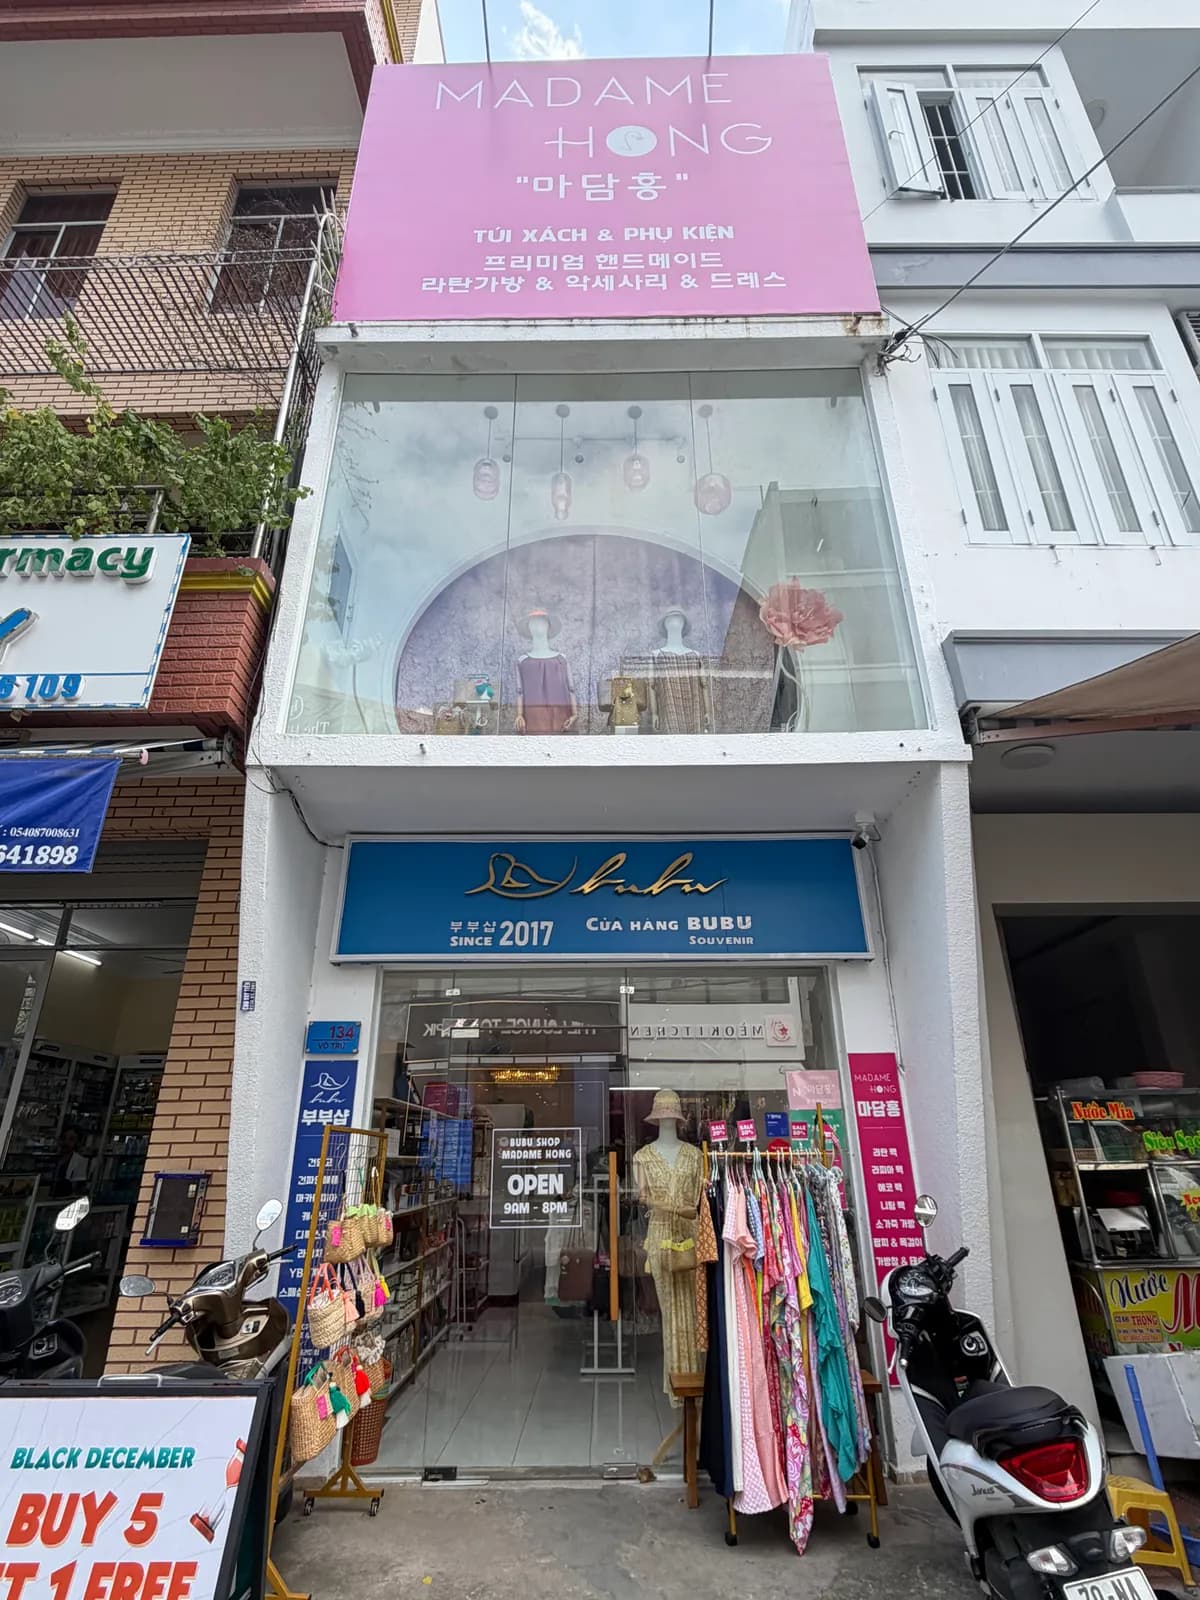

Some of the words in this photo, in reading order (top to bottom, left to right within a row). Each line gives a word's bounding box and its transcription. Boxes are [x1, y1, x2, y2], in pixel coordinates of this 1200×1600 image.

[436, 73, 732, 110] MADAME
[544, 122, 772, 159] HONG
[473, 225, 512, 243] TÚI
[522, 225, 587, 242] XÁCH
[597, 228, 615, 241] &
[624, 226, 673, 244] PHỤ
[682, 223, 735, 243] KIỆN
[483, 254, 584, 271] 프리미엄
[595, 252, 723, 270] 핸드메이드
[421, 276, 526, 293] 라탄가방
[535, 276, 554, 291] &
[565, 273, 668, 292] 악세사리
[680, 273, 699, 289] &
[710, 271, 787, 289] 드레스
[9, 826, 80, 838] 054087008631
[630, 917, 679, 931] HÀNG
[687, 916, 752, 931] BUBU
[449, 936, 493, 947] SINCE
[499, 920, 554, 947] 2017
[689, 935, 754, 945] SOUVENIR
[330, 1025, 354, 1039] 134
[854, 1073, 892, 1082] MADAME
[857, 1100, 901, 1117] 마담홍
[301, 1109, 350, 1126] 부부샵
[509, 1137, 533, 1148] BUBU
[536, 1137, 561, 1147] SHOP
[502, 1149, 542, 1160] MADAME
[545, 1149, 572, 1159] HONG
[507, 1173, 564, 1196] OPEN
[295, 1193, 338, 1203] 마카미아
[301, 1211, 327, 1221] 캐넛
[503, 1202, 530, 1214] 9AM
[542, 1201, 568, 1213] 8PM
[10, 1447, 83, 1470] BLACK
[84, 1447, 196, 1470] DECEMBER
[5, 1490, 118, 1547] BUY
[123, 1492, 164, 1547] 5
[0, 1562, 40, 1600] T
[50, 1560, 78, 1600] 1
[83, 1561, 198, 1600] FREE
